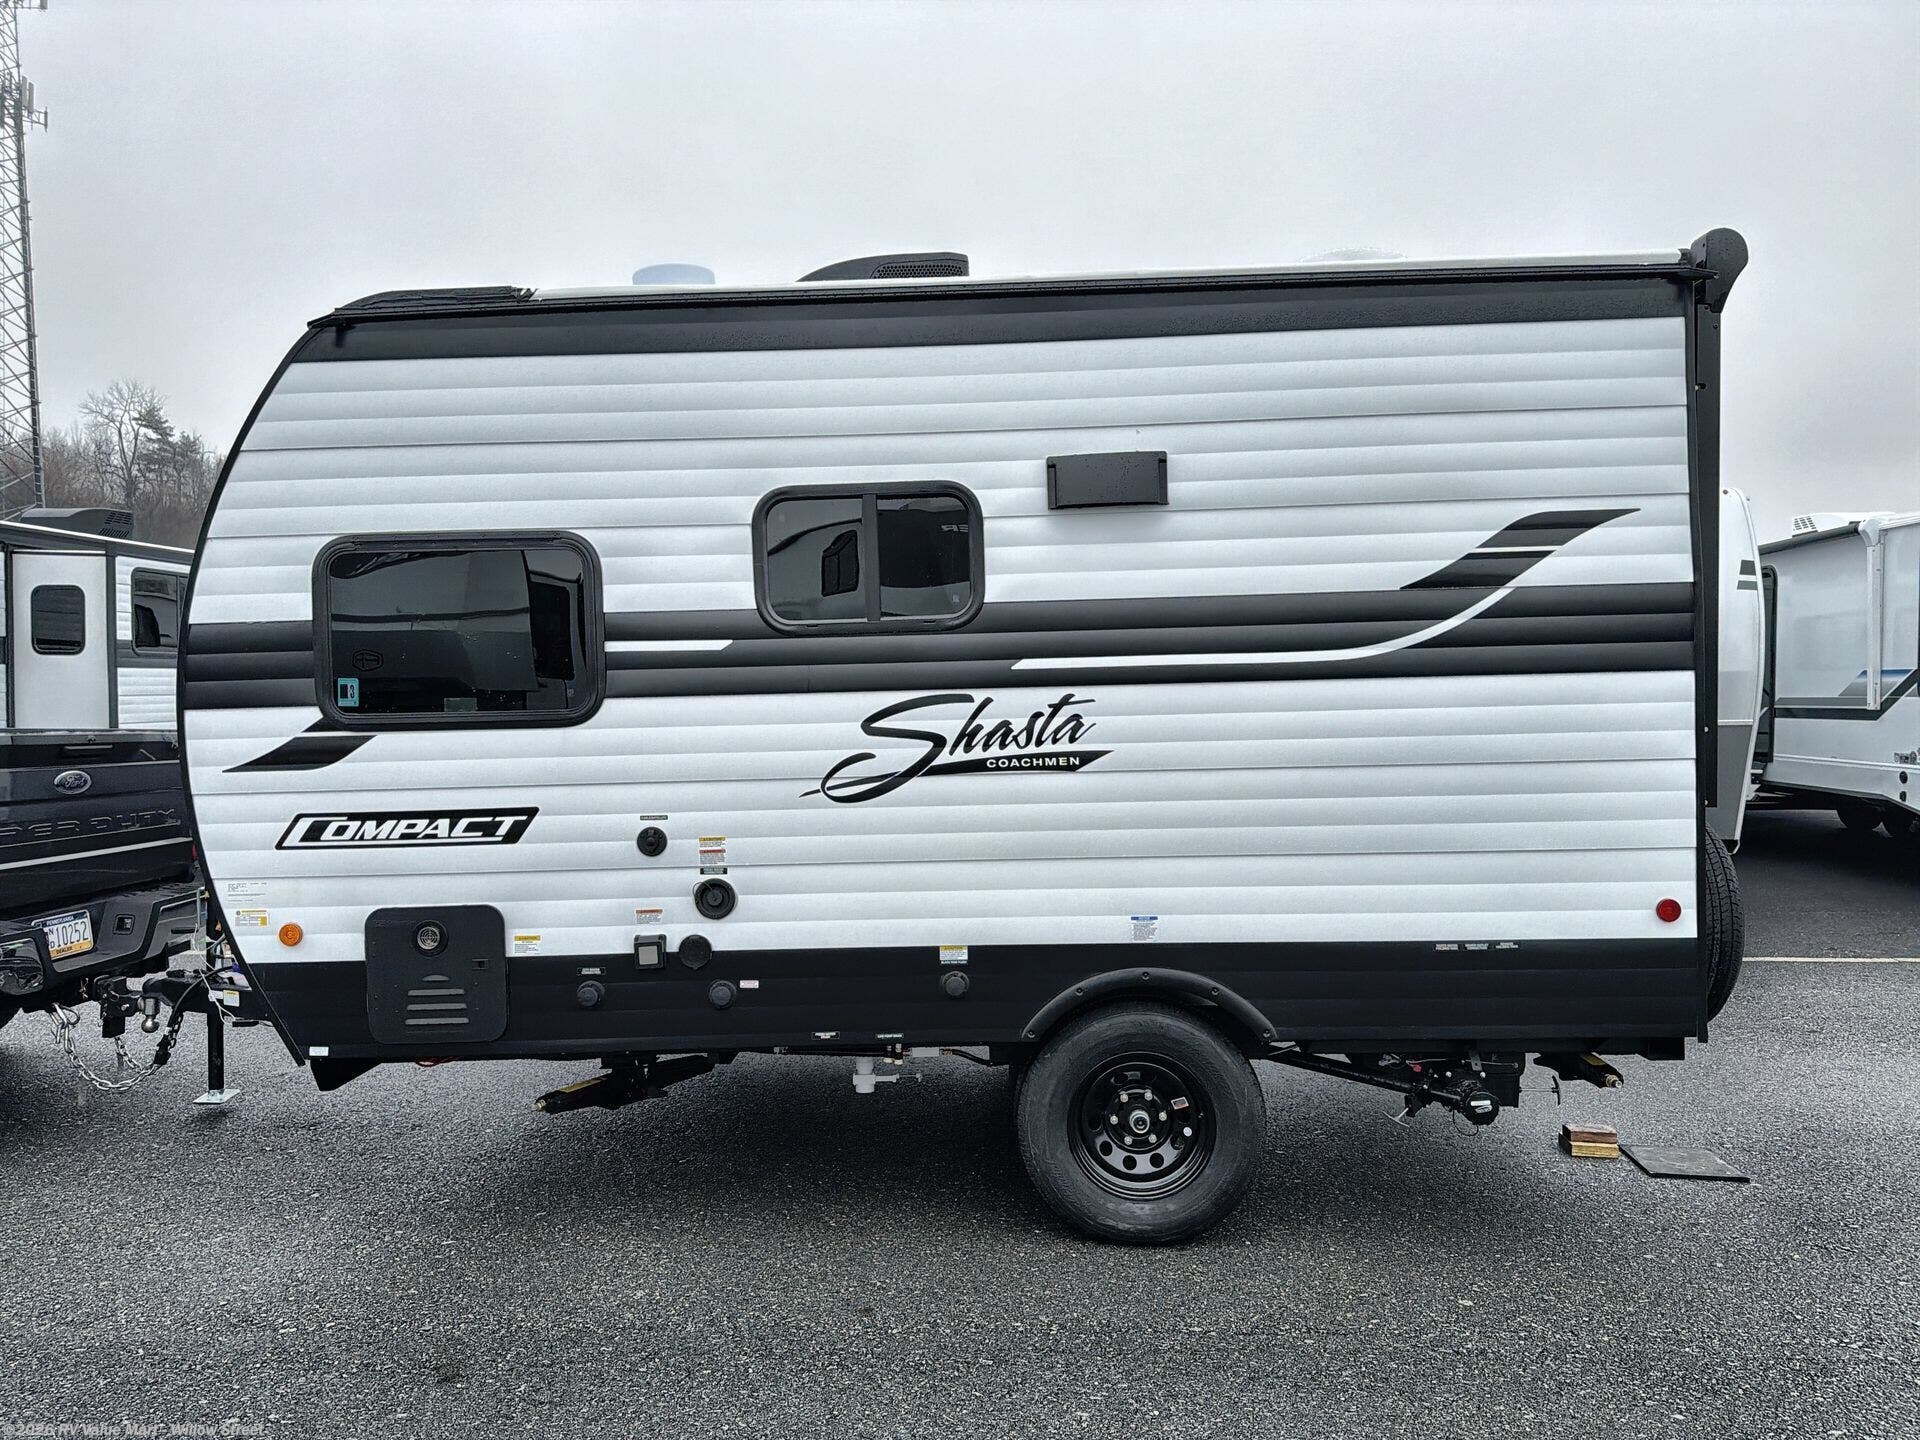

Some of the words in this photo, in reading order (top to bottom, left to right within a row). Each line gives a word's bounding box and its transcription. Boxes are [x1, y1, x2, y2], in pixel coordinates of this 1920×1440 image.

[820, 693, 1097, 803] Shasta
[986, 756, 1080, 768] COACHMEN
[90, 809, 175, 829] DUTY
[282, 815, 528, 848] COMPACT
[55, 920, 89, 948] 10252
